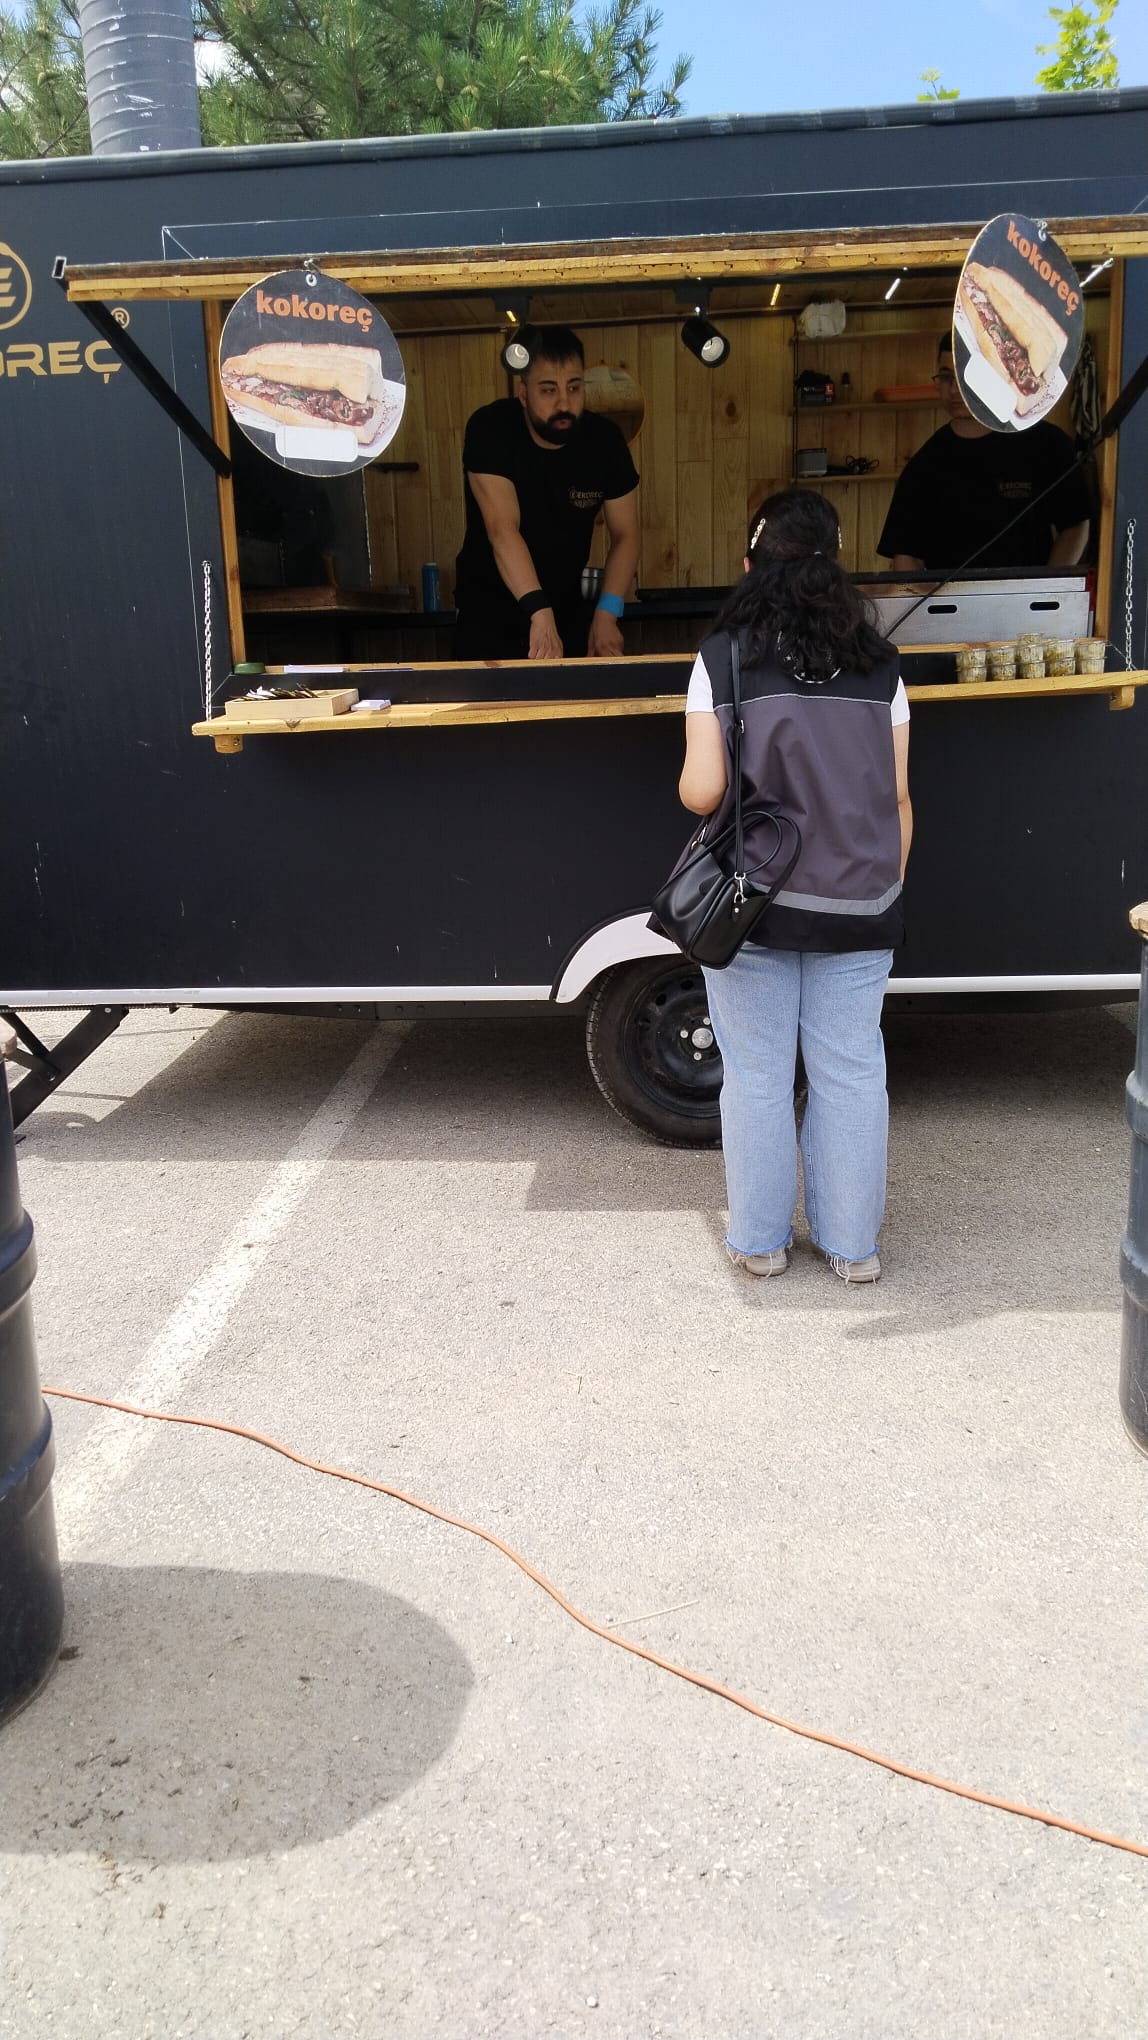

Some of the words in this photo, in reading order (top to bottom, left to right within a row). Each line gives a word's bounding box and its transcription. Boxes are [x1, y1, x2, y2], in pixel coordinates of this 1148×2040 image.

[1007, 219, 1079, 316] kokoreç
[256, 289, 373, 333] kokoreç
[0, 340, 122, 384] REÇ
